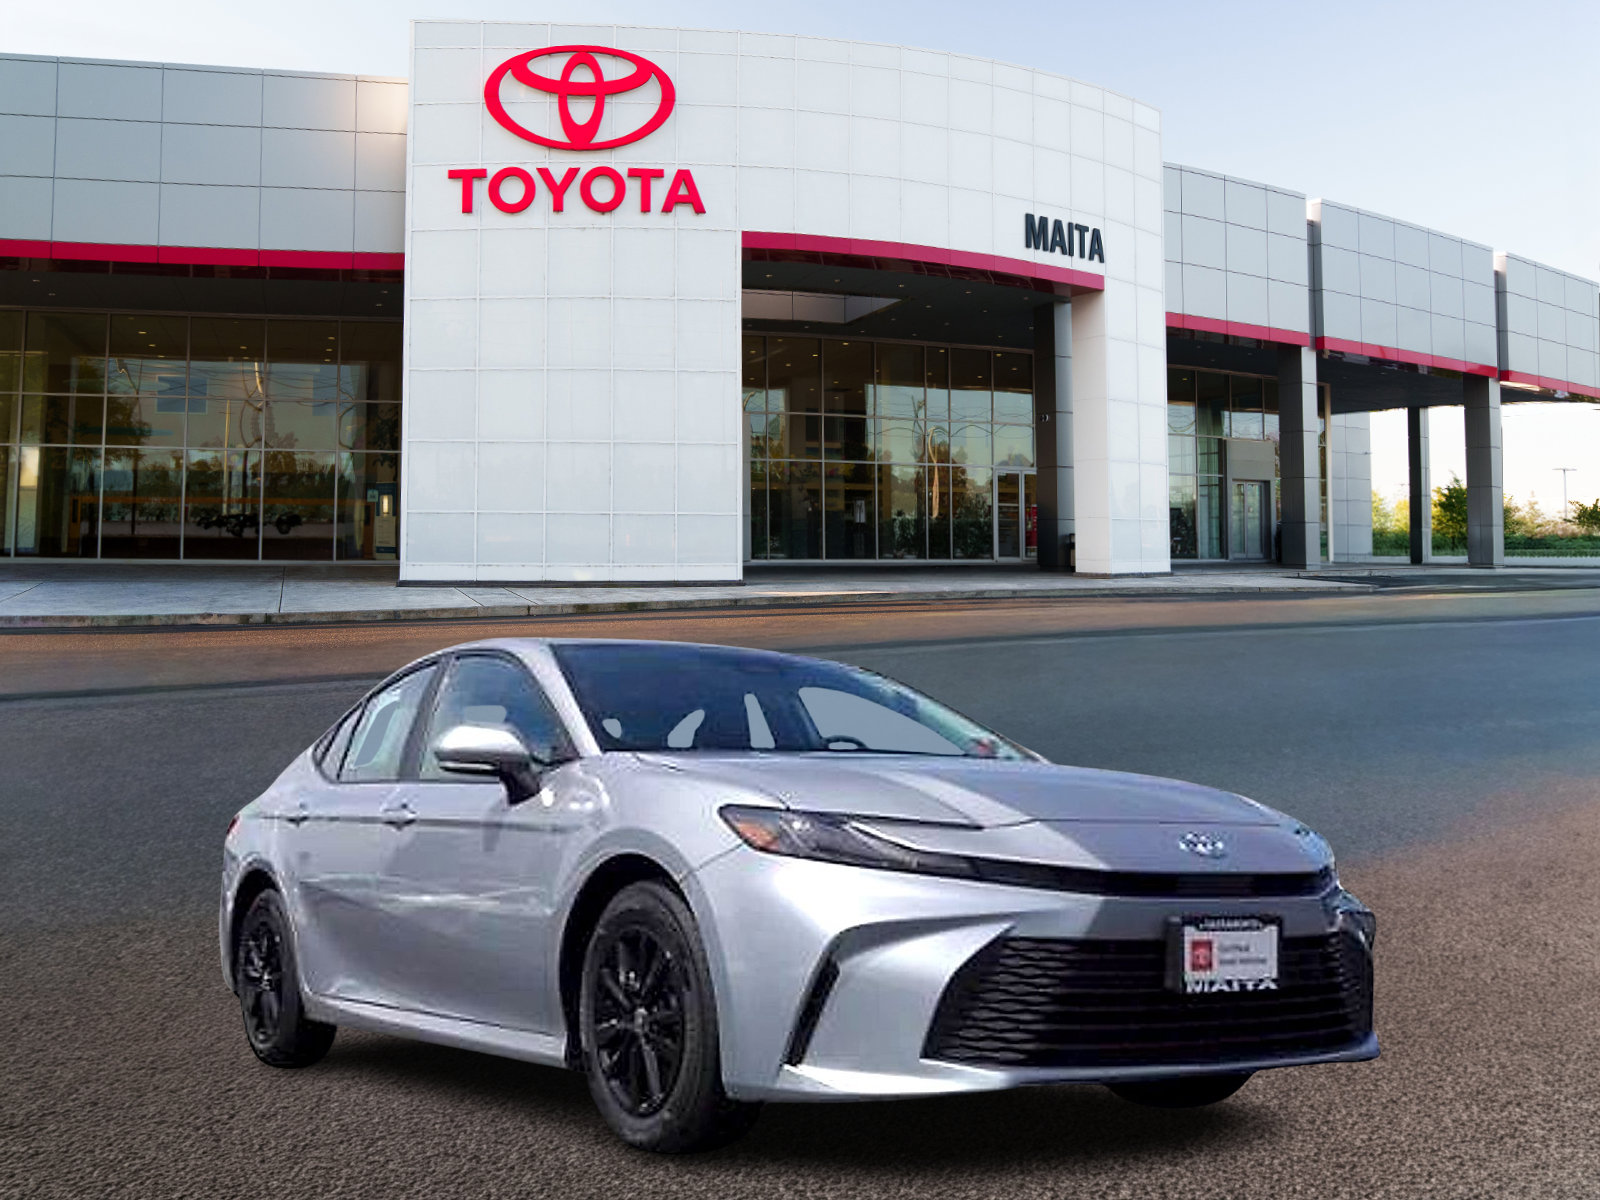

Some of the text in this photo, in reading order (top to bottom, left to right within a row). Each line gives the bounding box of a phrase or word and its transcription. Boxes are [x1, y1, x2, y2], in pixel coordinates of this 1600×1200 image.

[448, 166, 706, 214] TOYOTA
[1025, 213, 1105, 263] MAITA
[1185, 978, 1279, 993] MAITA
